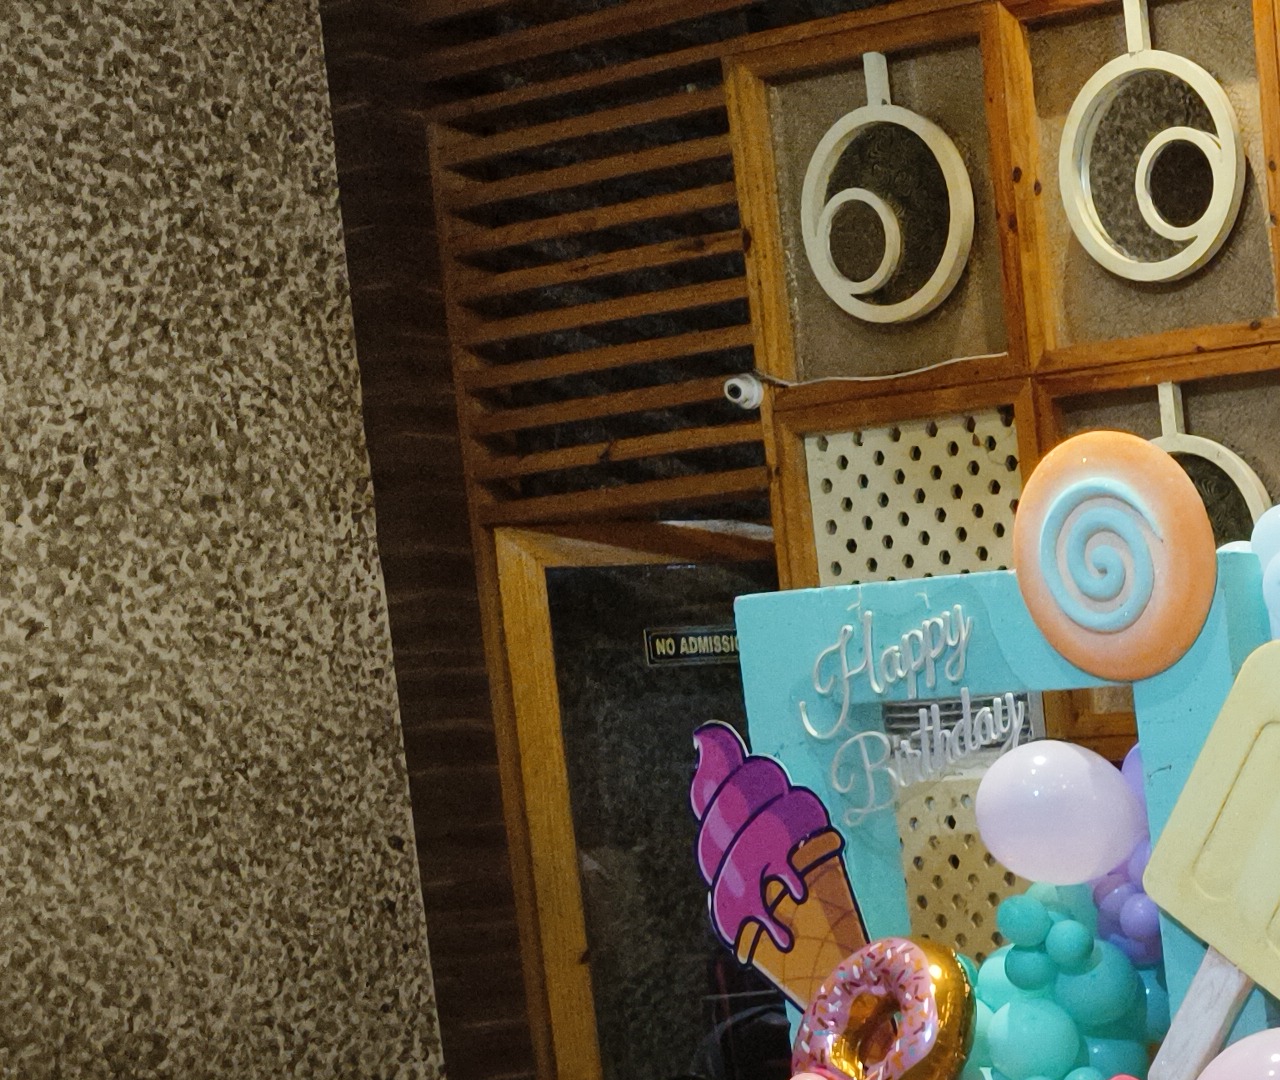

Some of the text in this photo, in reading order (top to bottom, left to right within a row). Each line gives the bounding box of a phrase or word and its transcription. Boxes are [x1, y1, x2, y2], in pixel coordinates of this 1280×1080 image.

[655, 637, 676, 656] NO
[800, 604, 974, 740] Happy
[832, 687, 1025, 827] Birthday
